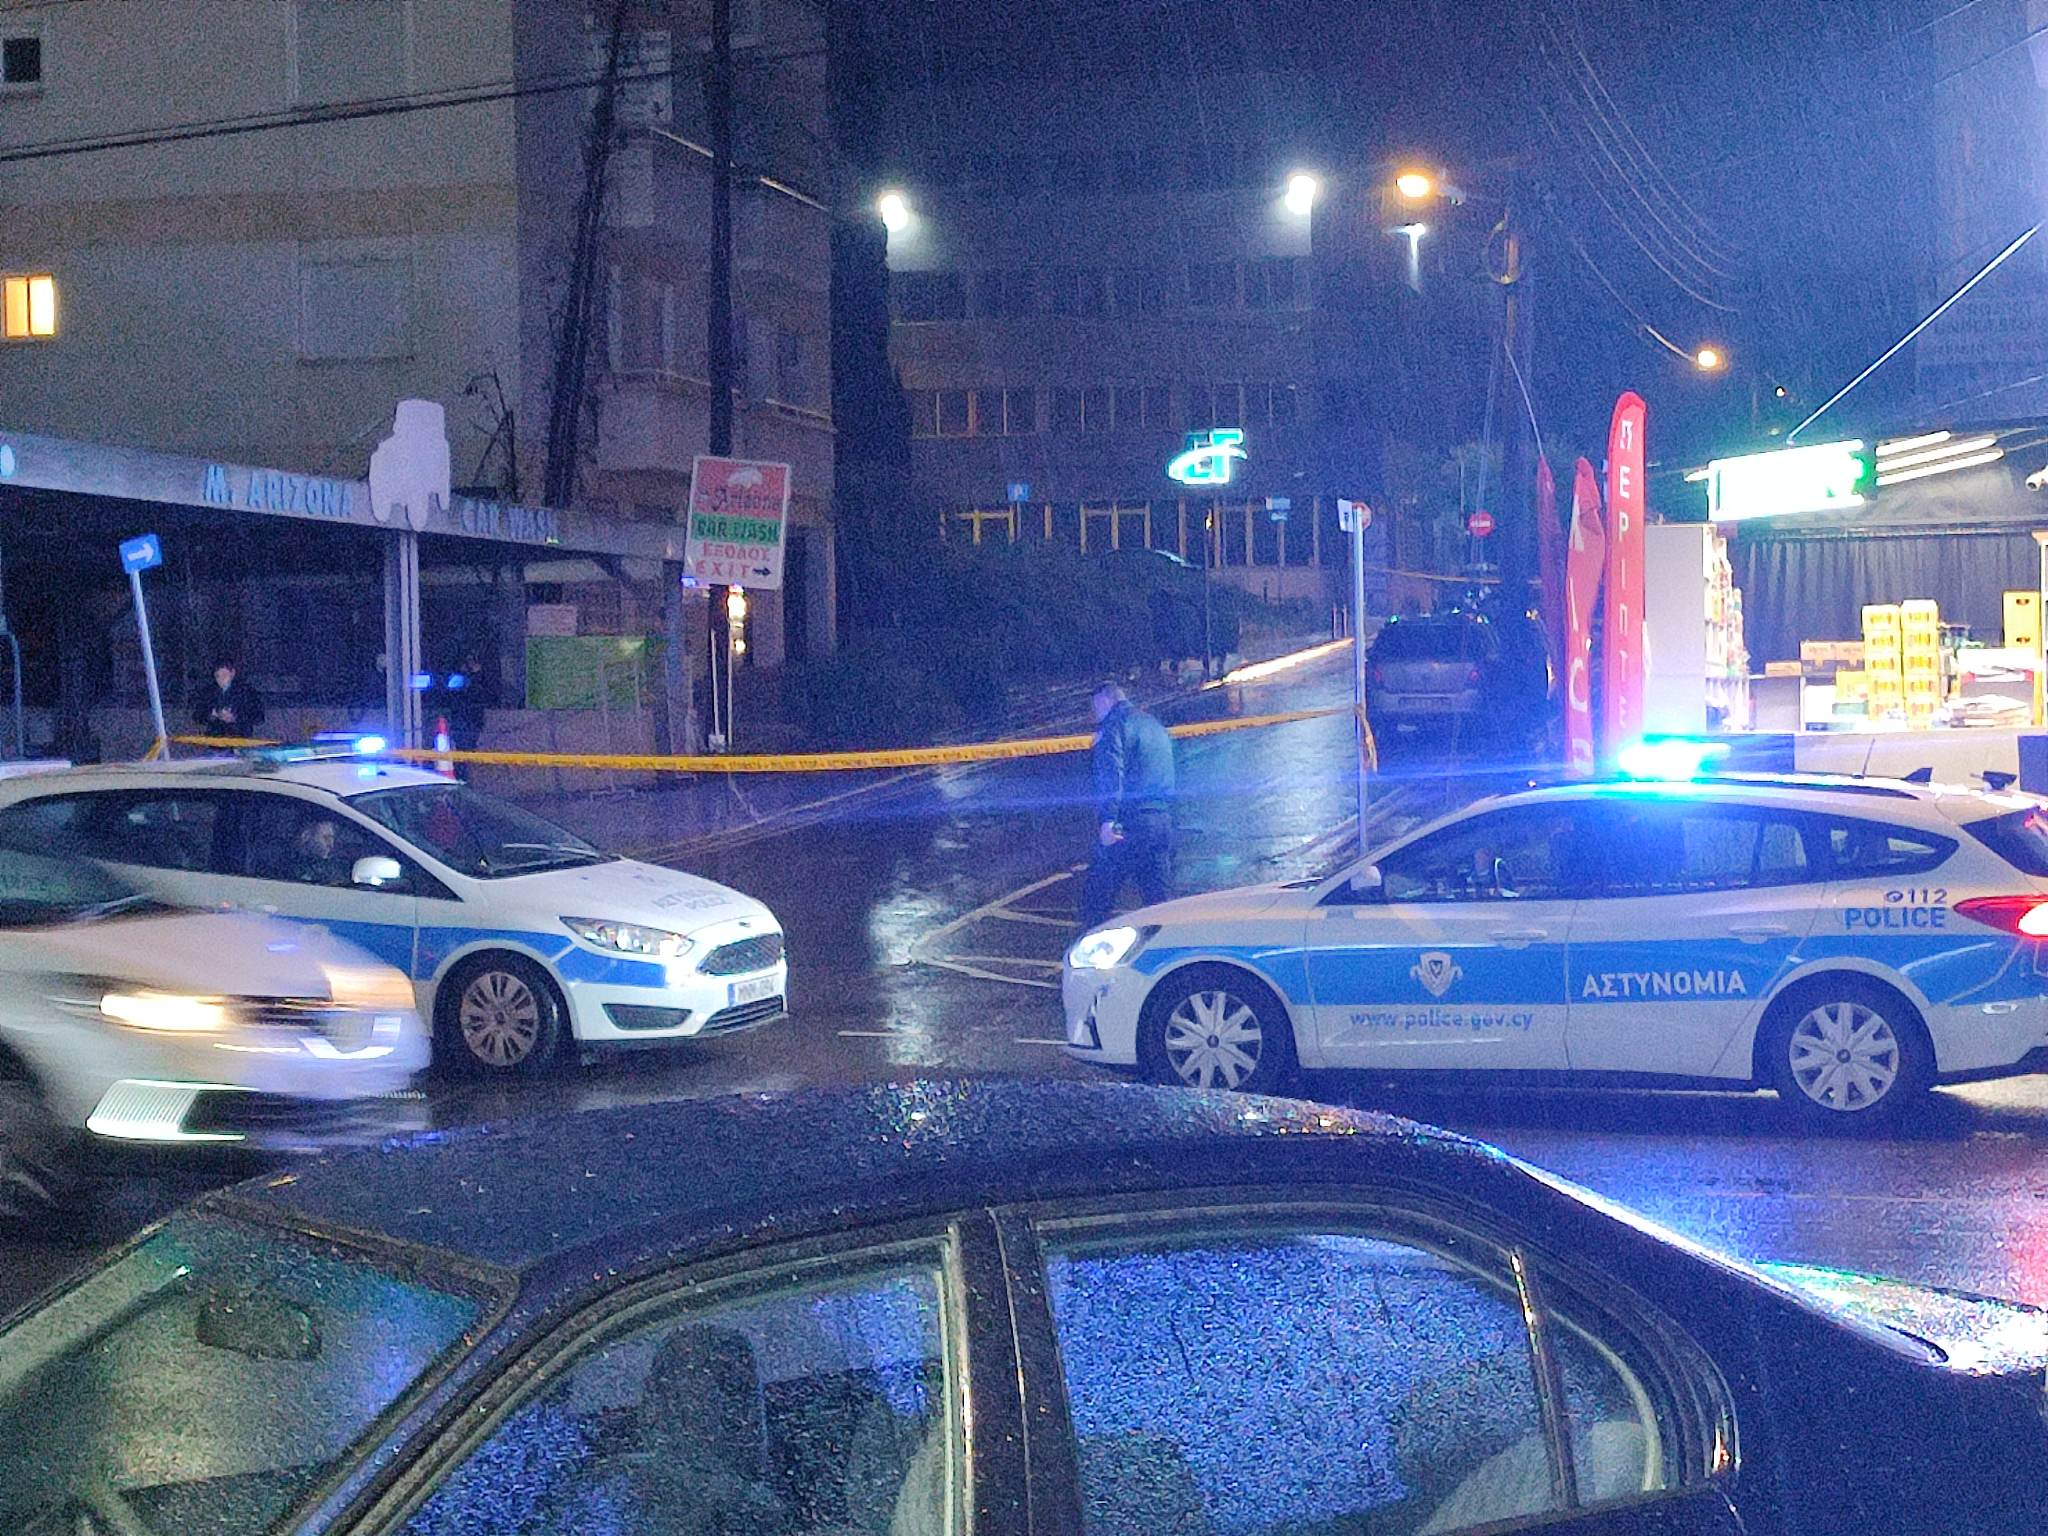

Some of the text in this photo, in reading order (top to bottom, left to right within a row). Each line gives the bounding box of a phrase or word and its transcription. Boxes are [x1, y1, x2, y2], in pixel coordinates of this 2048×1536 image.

[247, 470, 353, 518] ARIZONA
[694, 560, 751, 579] EXIT
[1845, 907, 1946, 930] POLICE
[1582, 969, 1748, 998] ΑΣΤΥΝΟΜΙΑ
[1349, 1008, 1534, 1031] www.police.gov.cy
